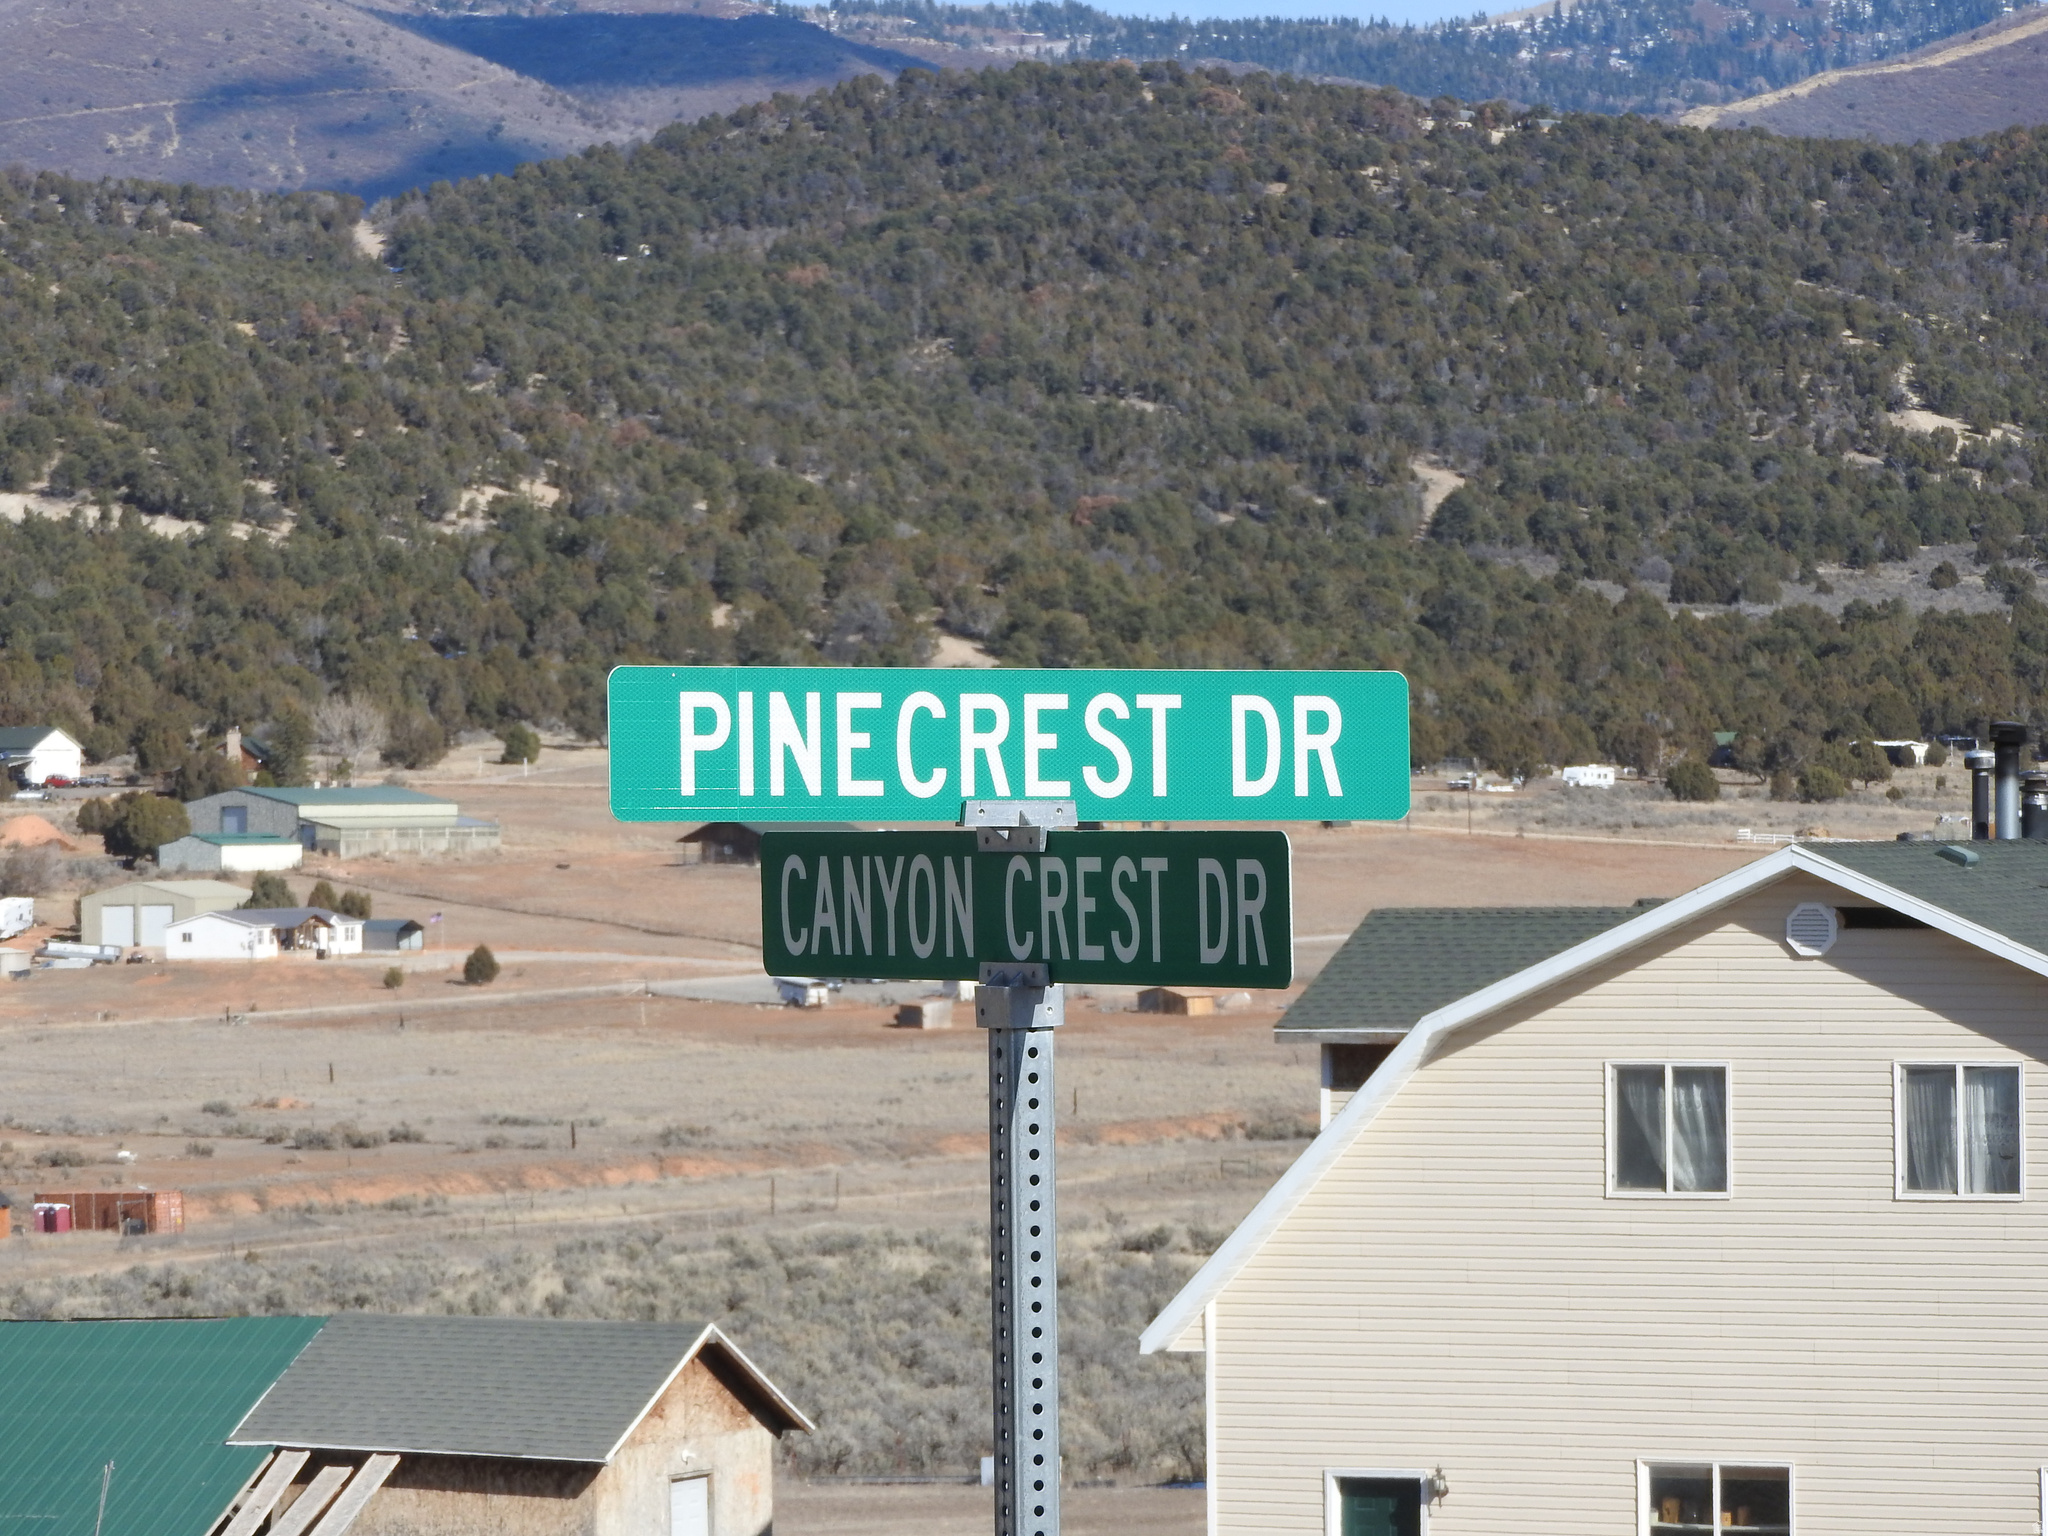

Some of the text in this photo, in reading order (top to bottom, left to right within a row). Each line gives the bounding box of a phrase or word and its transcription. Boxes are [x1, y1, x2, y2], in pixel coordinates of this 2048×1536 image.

[678, 690, 1344, 799] PINECREST DR
[780, 853, 1269, 967] CANYON CREST DR
